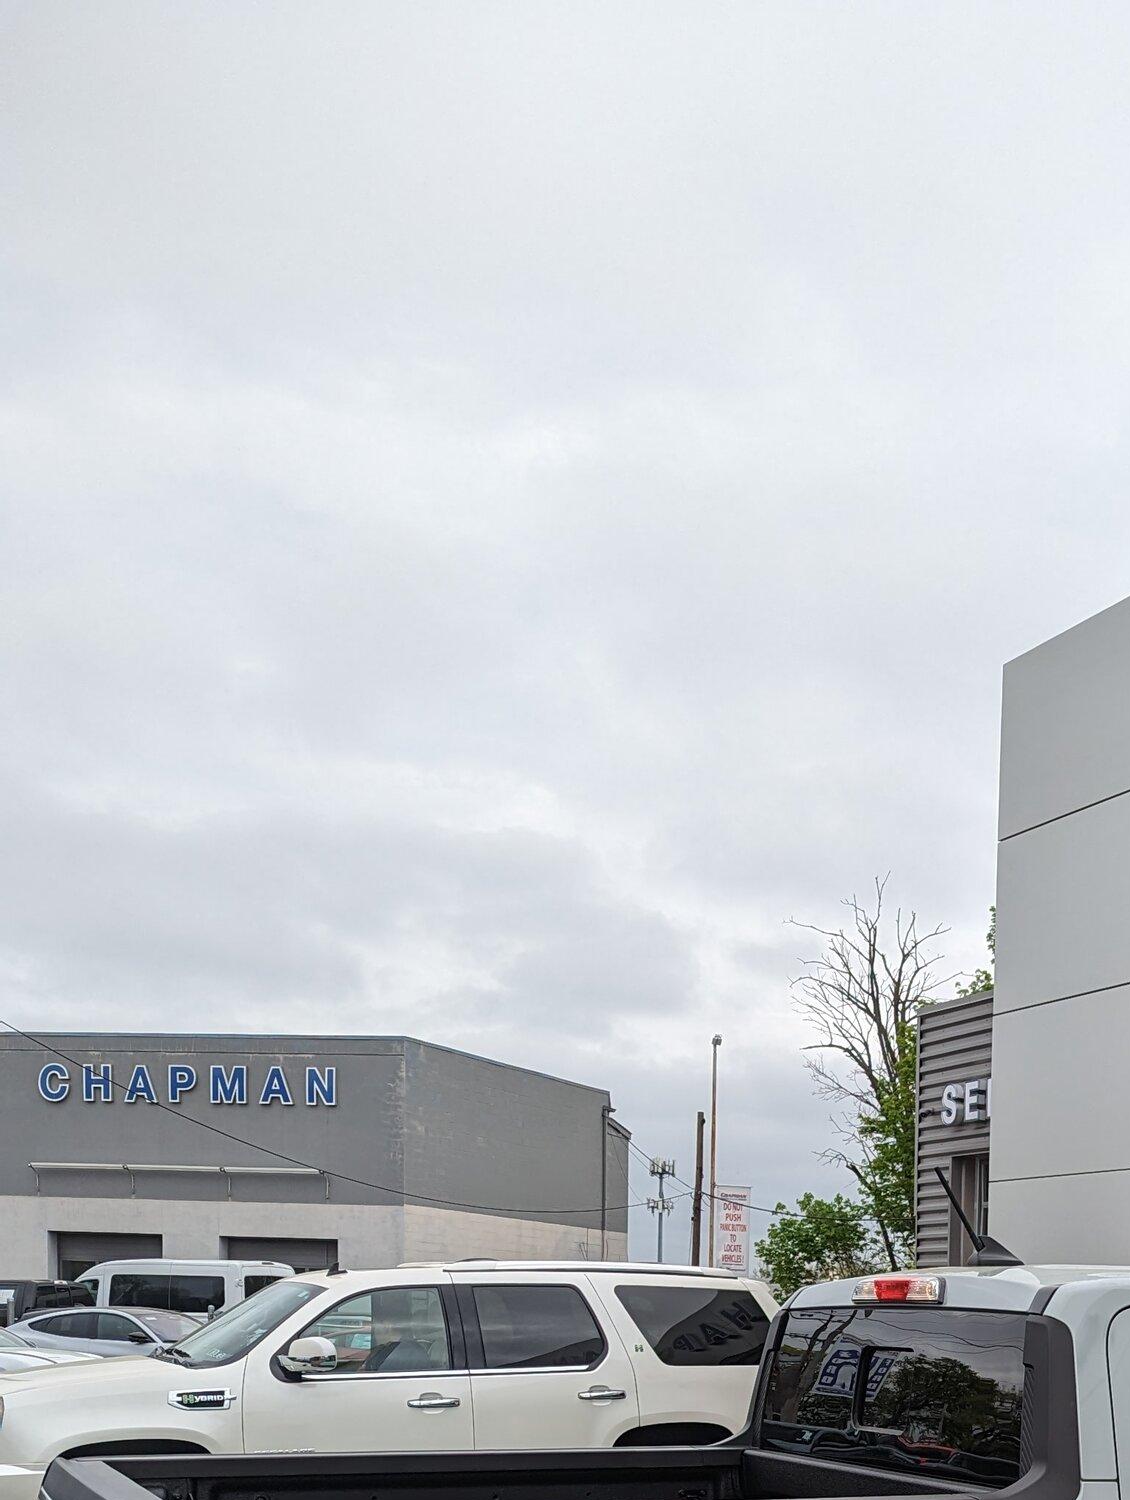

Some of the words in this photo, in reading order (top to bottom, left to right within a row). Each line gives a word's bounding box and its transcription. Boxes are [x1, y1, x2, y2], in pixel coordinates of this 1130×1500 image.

[38, 1063, 338, 1106] CHAPMAN
[723, 1202, 731, 1211] DO
[725, 1213, 742, 1222] PUSH
[720, 1223, 732, 1232] PANIC
[732, 1224, 747, 1233] BUTTON
[730, 1234, 737, 1243] TO
[723, 1244, 742, 1253] LOCATE
